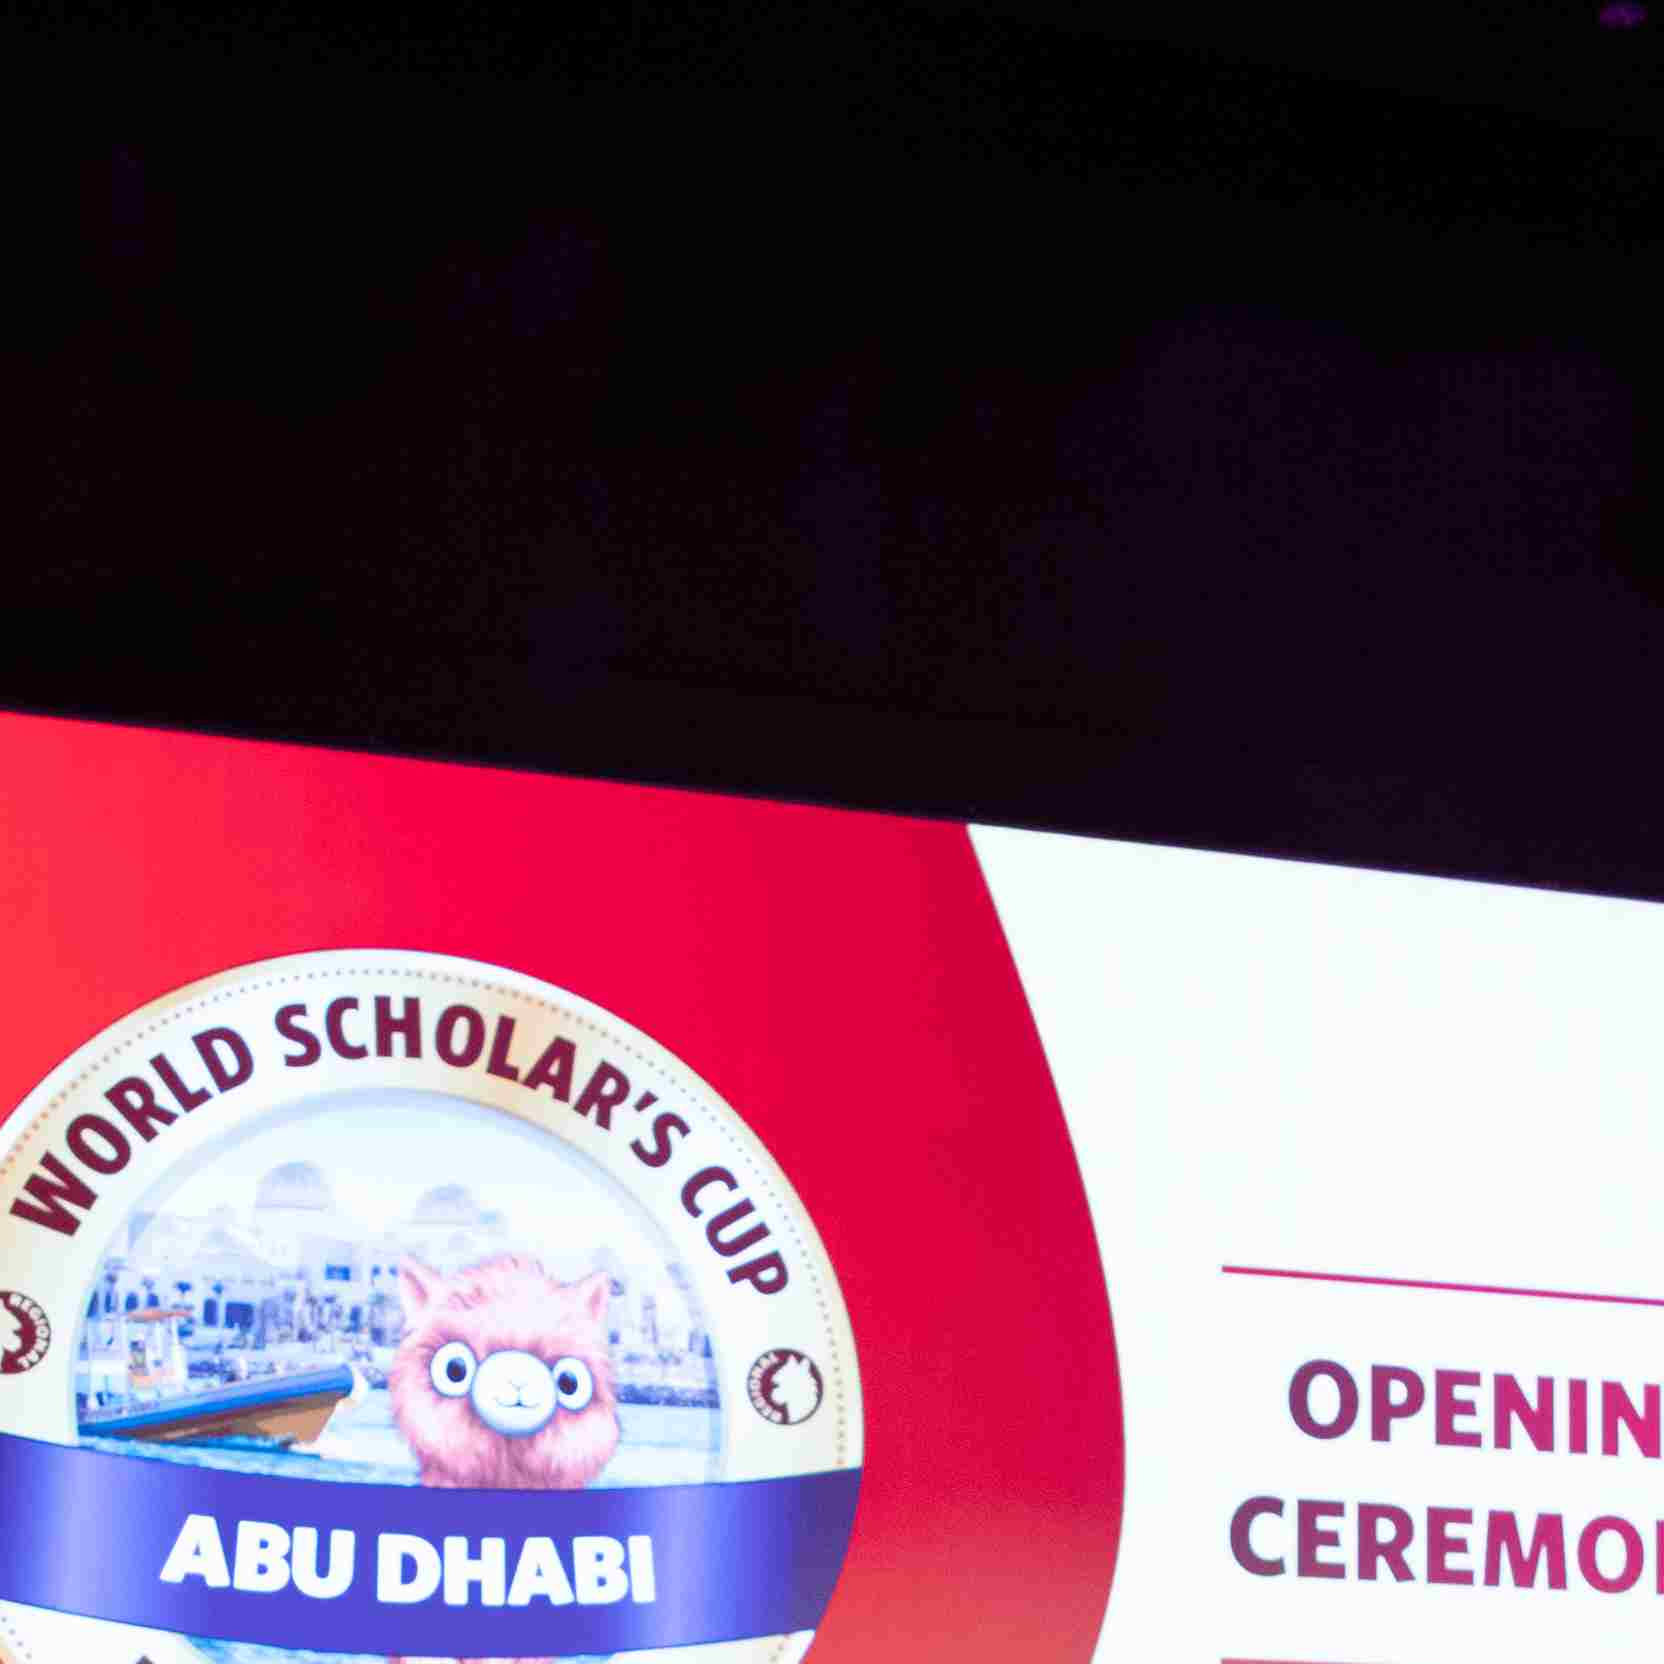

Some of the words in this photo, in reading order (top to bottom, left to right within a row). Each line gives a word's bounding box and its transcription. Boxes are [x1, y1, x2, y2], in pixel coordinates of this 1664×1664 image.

[9, 1026, 254, 1236] WORLD
[274, 996, 691, 1168] SCHOLAR'S
[681, 1166, 789, 1294] CUP
[159, 1513, 357, 1600] ABU
[377, 1533, 659, 1608] DHABI
